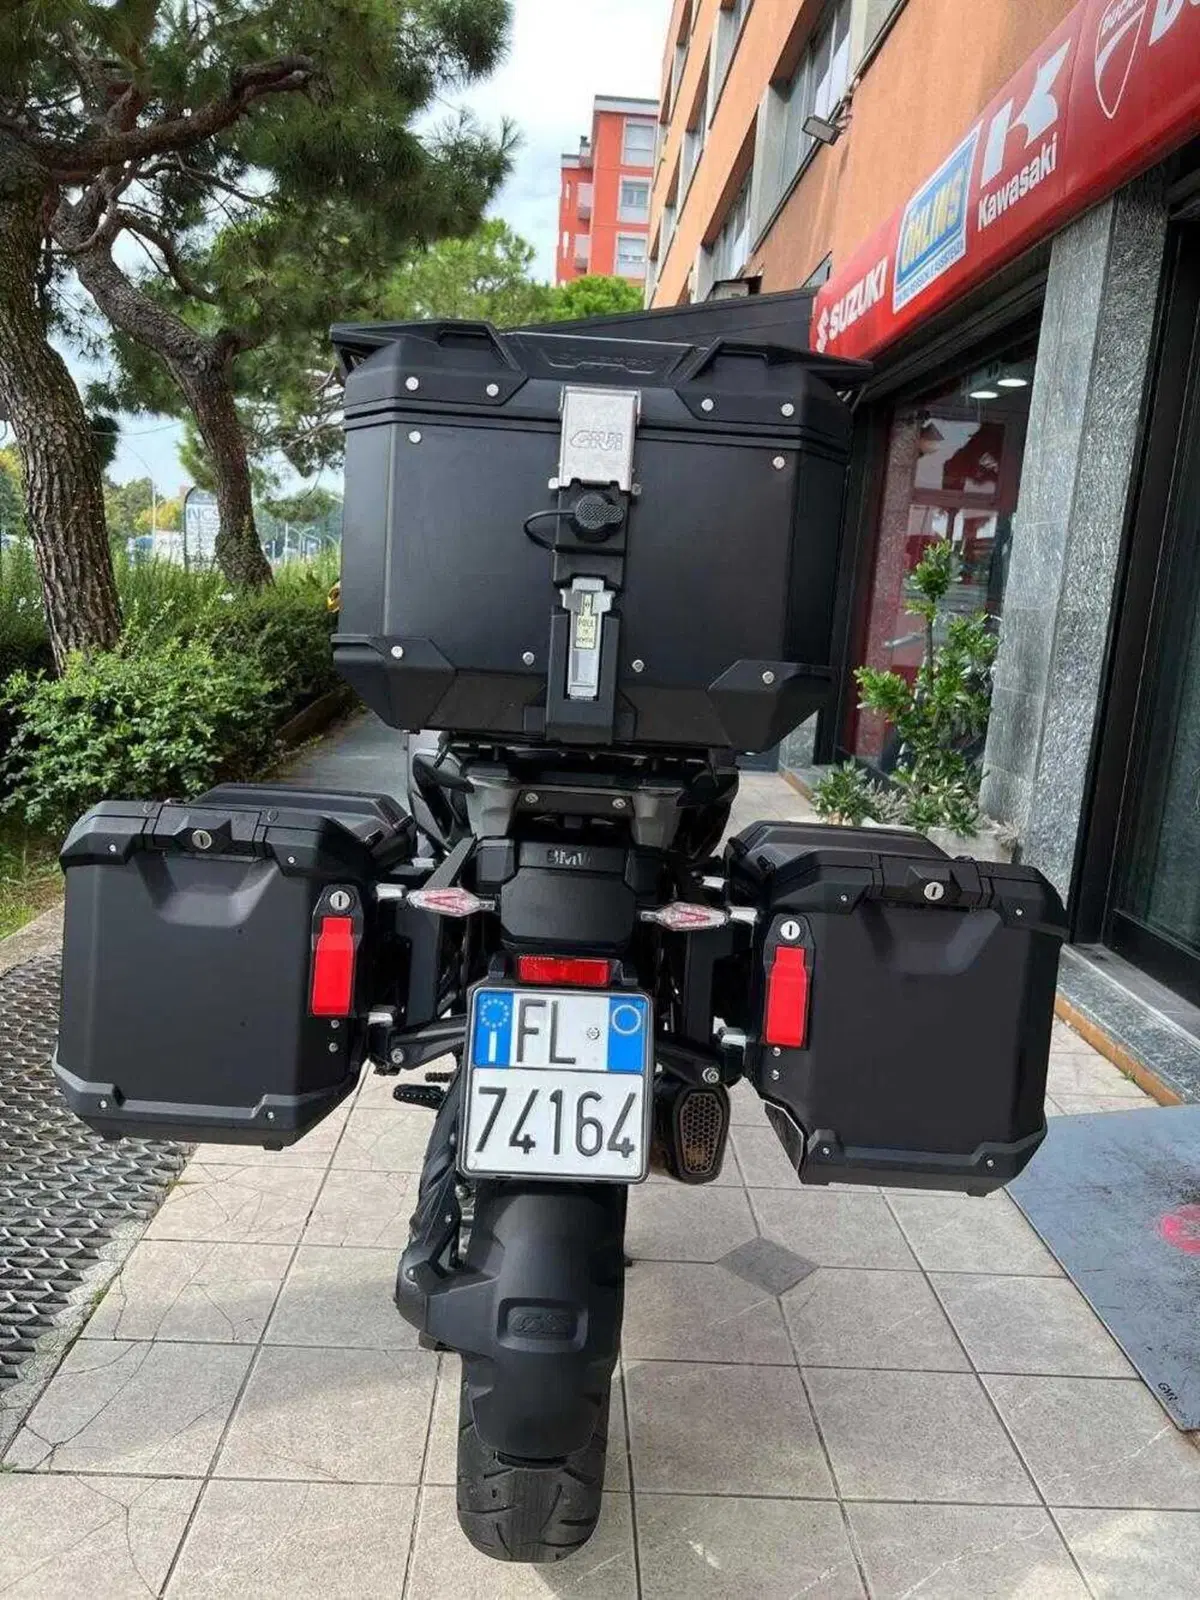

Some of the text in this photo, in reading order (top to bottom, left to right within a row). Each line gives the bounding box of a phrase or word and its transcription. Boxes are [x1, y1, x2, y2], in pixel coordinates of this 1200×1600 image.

[978, 131, 1057, 232] Kawasaki
[829, 255, 888, 341] SUZUKI
[516, 999, 576, 1065] FL
[475, 1087, 637, 1158] 74164
